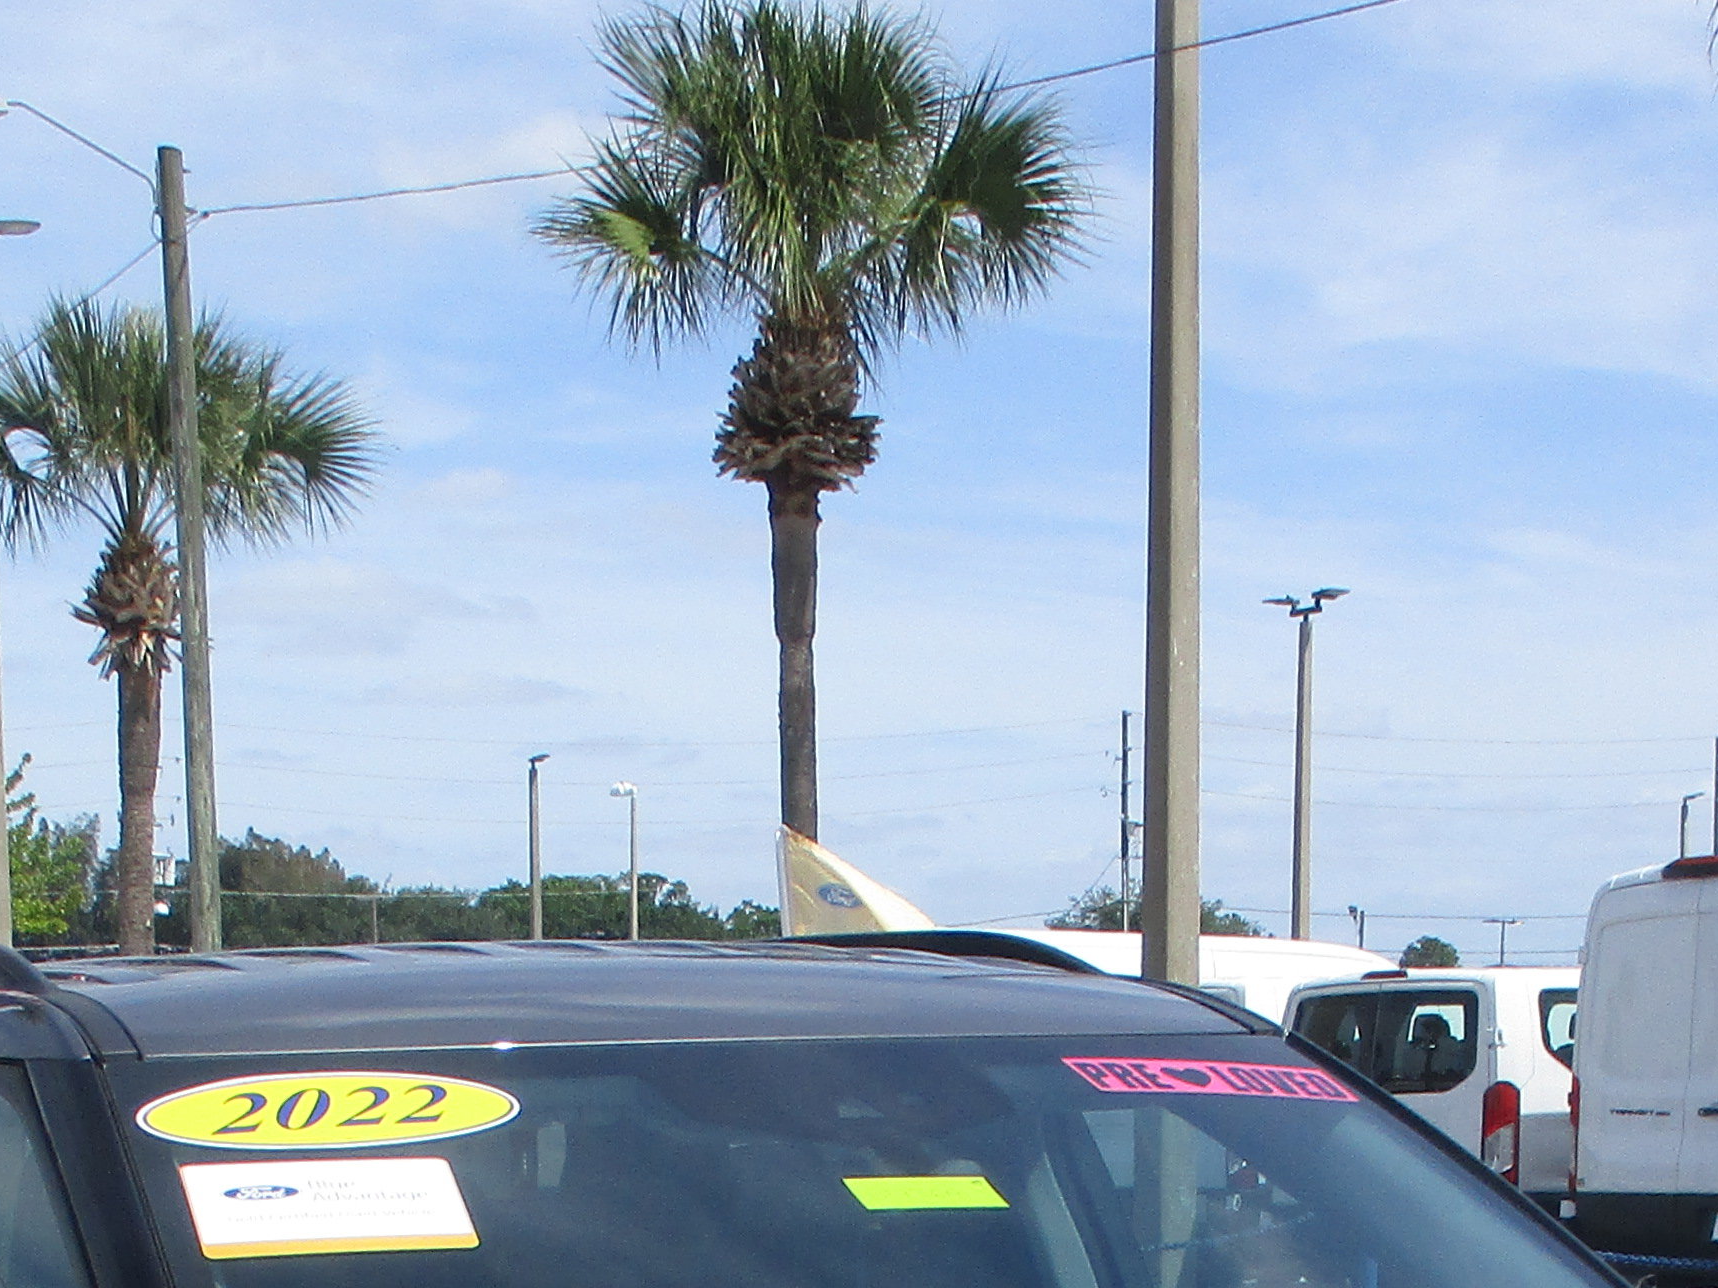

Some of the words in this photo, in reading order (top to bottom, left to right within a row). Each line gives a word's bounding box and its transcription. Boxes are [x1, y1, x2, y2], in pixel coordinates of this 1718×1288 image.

[1072, 1062, 1175, 1090] PRE
[1205, 1065, 1348, 1099] LOVED
[211, 1083, 448, 1136] 2022
